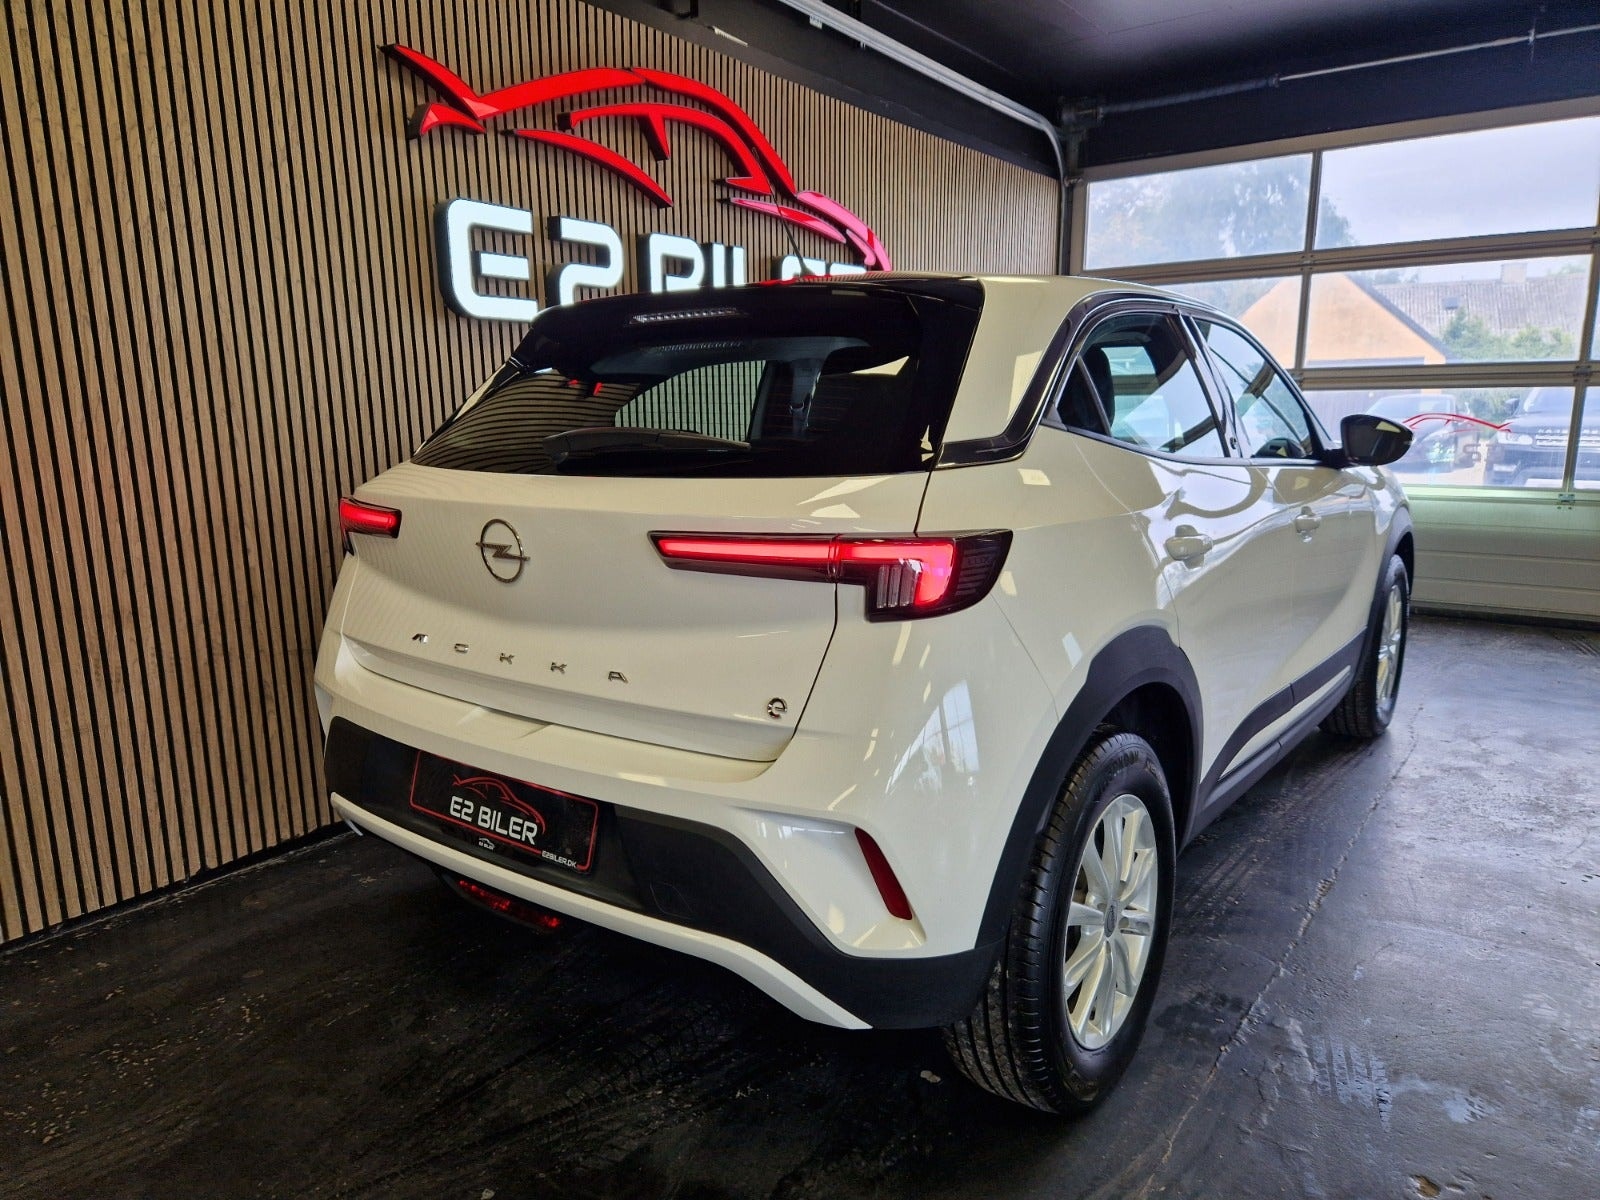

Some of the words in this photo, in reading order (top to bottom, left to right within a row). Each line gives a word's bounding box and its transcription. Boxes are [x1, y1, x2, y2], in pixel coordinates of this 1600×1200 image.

[444, 197, 624, 323] E2
[450, 795, 474, 822] E2
[478, 806, 538, 846] BILER
